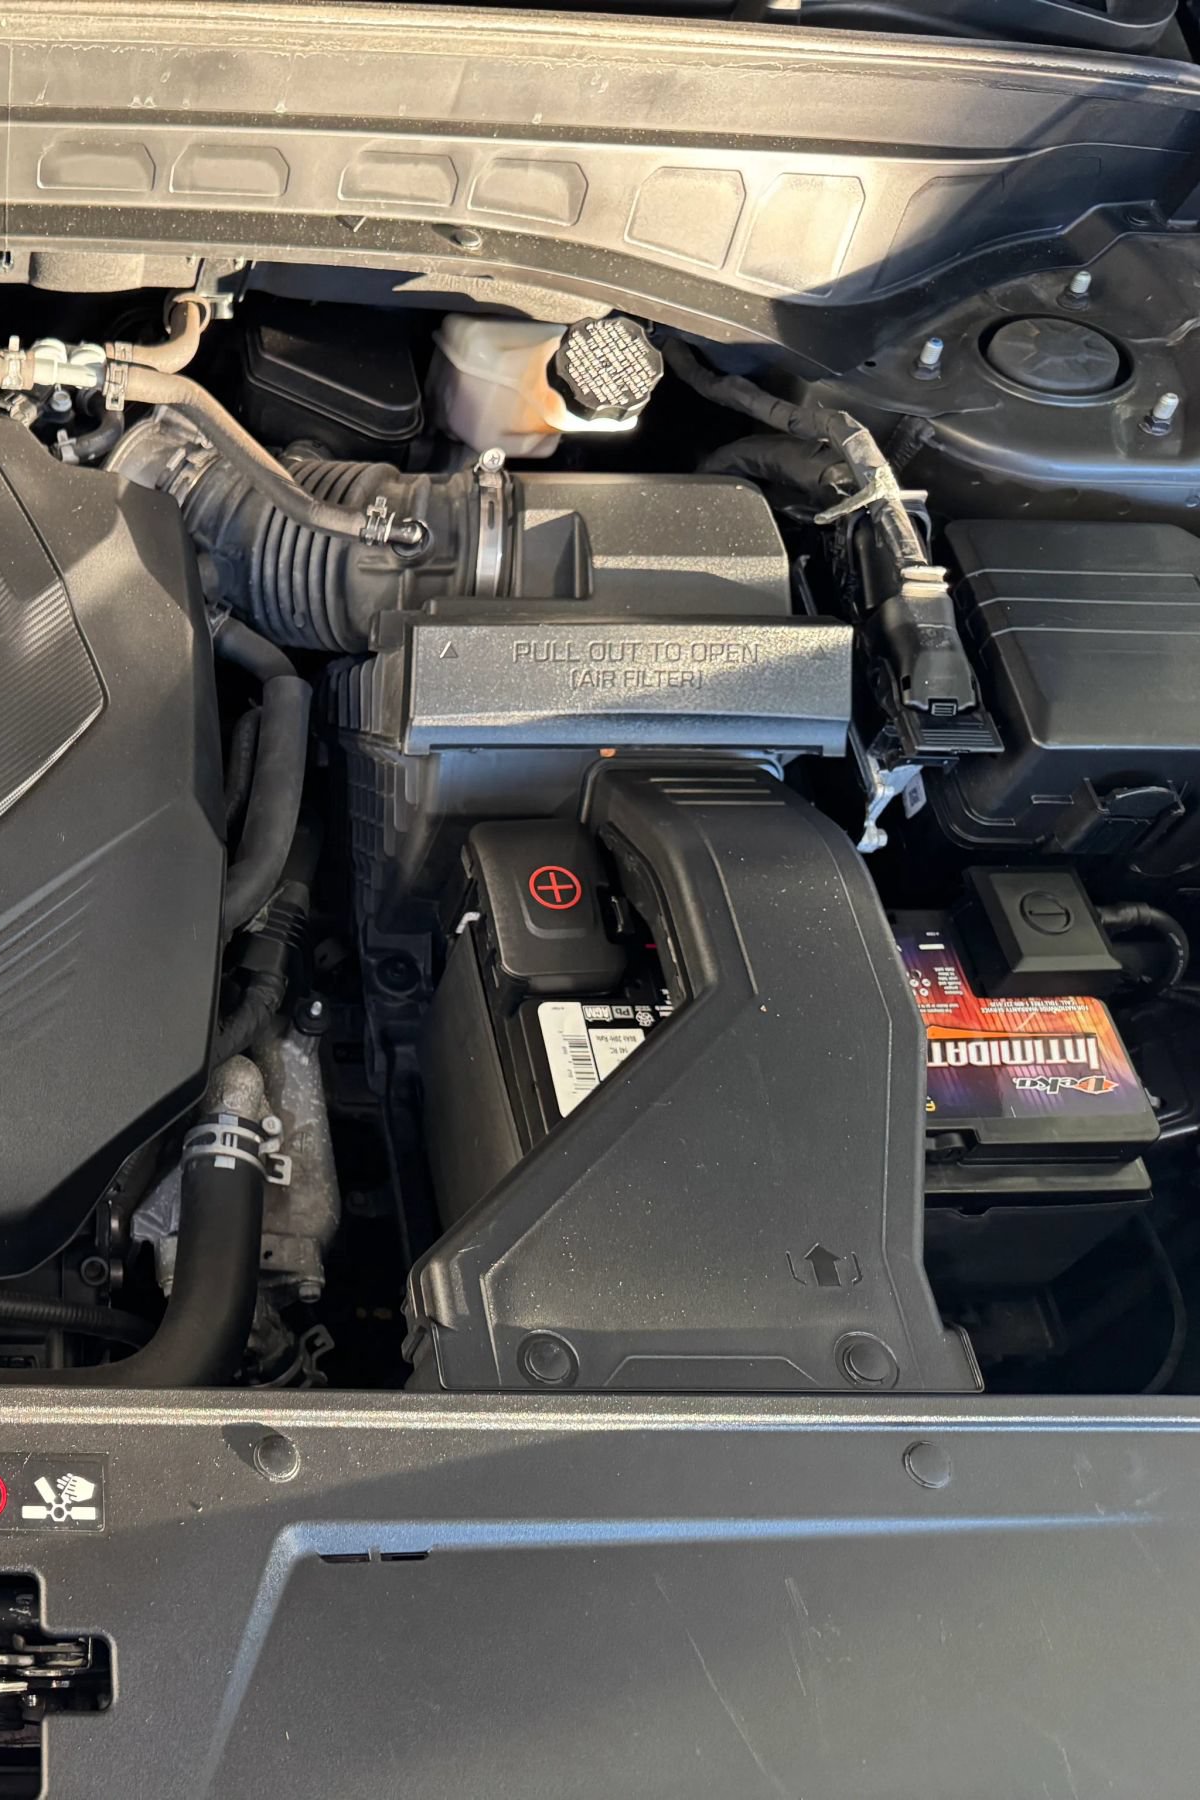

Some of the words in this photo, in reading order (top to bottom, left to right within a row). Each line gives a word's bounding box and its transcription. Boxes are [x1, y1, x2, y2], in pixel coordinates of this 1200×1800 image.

[513, 639, 580, 663] PULL
[588, 639, 643, 663] OUT
[647, 641, 681, 663] TO
[691, 641, 758, 663] OPEN
[615, 1007, 631, 1016] Pb
[927, 1037, 1100, 1069] INTIMIDAT
[1015, 1075, 1119, 1094] Deka
